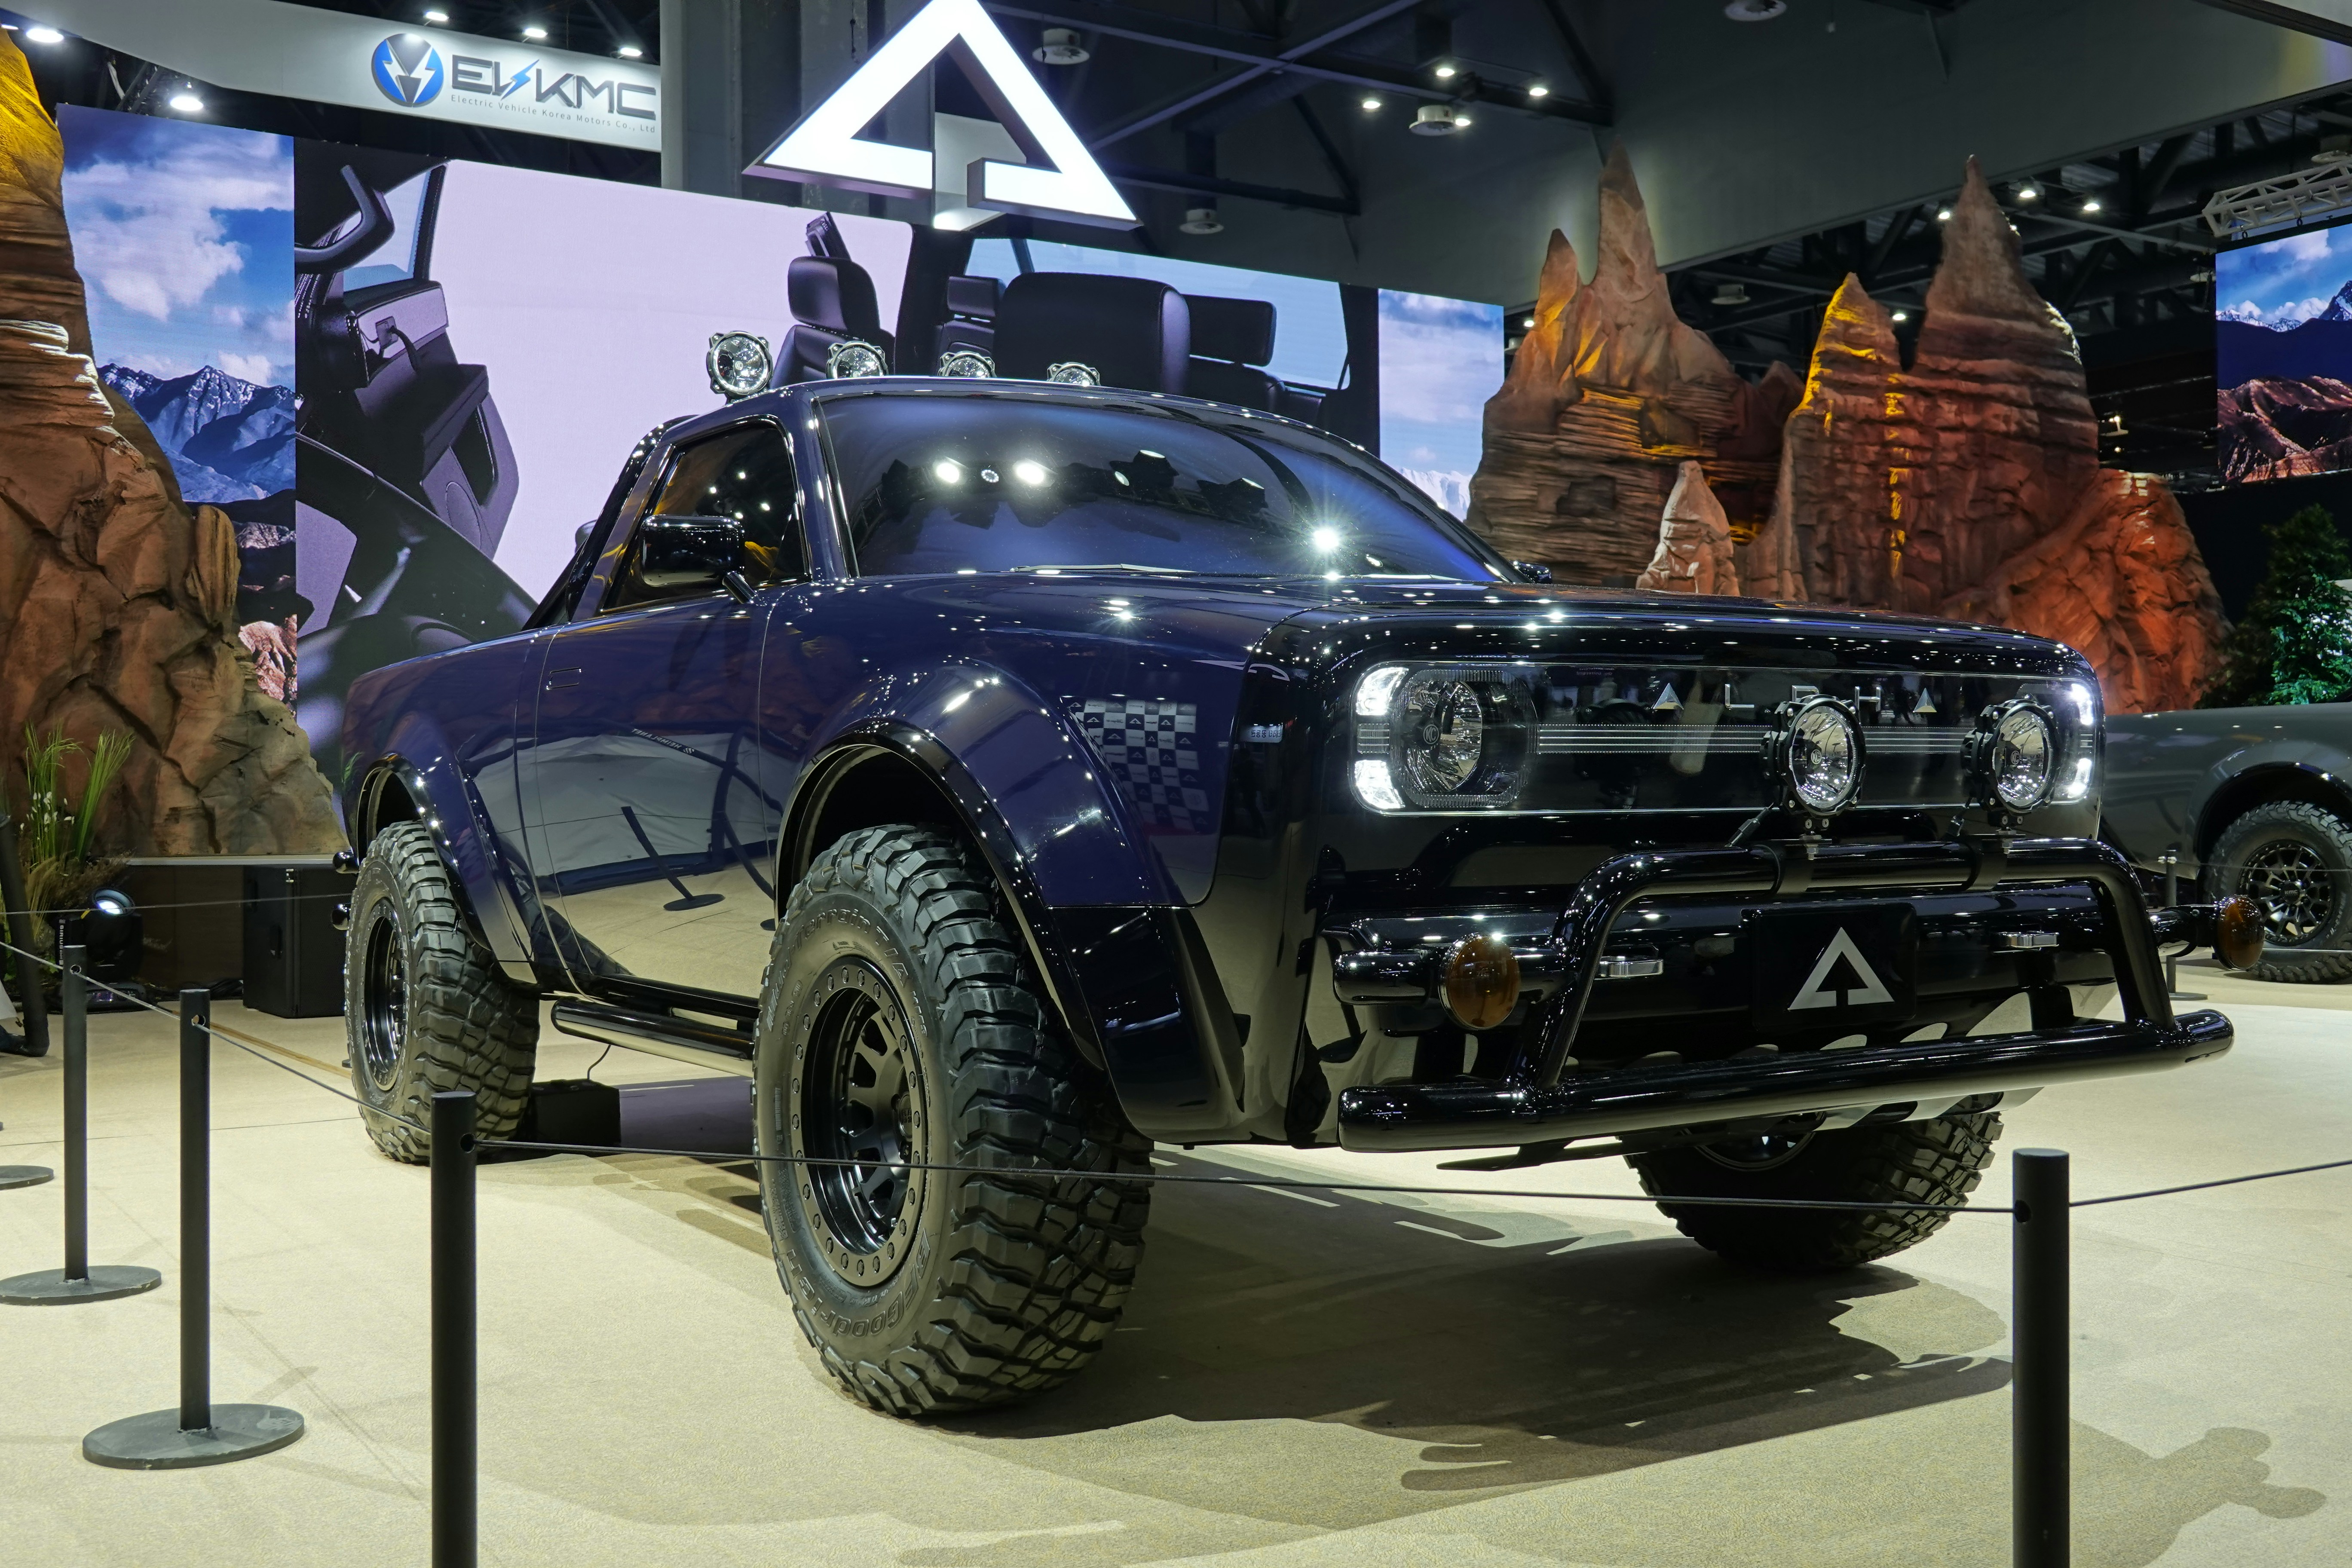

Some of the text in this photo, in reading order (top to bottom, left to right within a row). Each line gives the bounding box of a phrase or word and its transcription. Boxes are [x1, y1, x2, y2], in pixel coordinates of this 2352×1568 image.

[451, 94, 655, 133] Electric Vehicle Korea Motors Co., Ltd
[1425, 726, 1436, 742] KC
